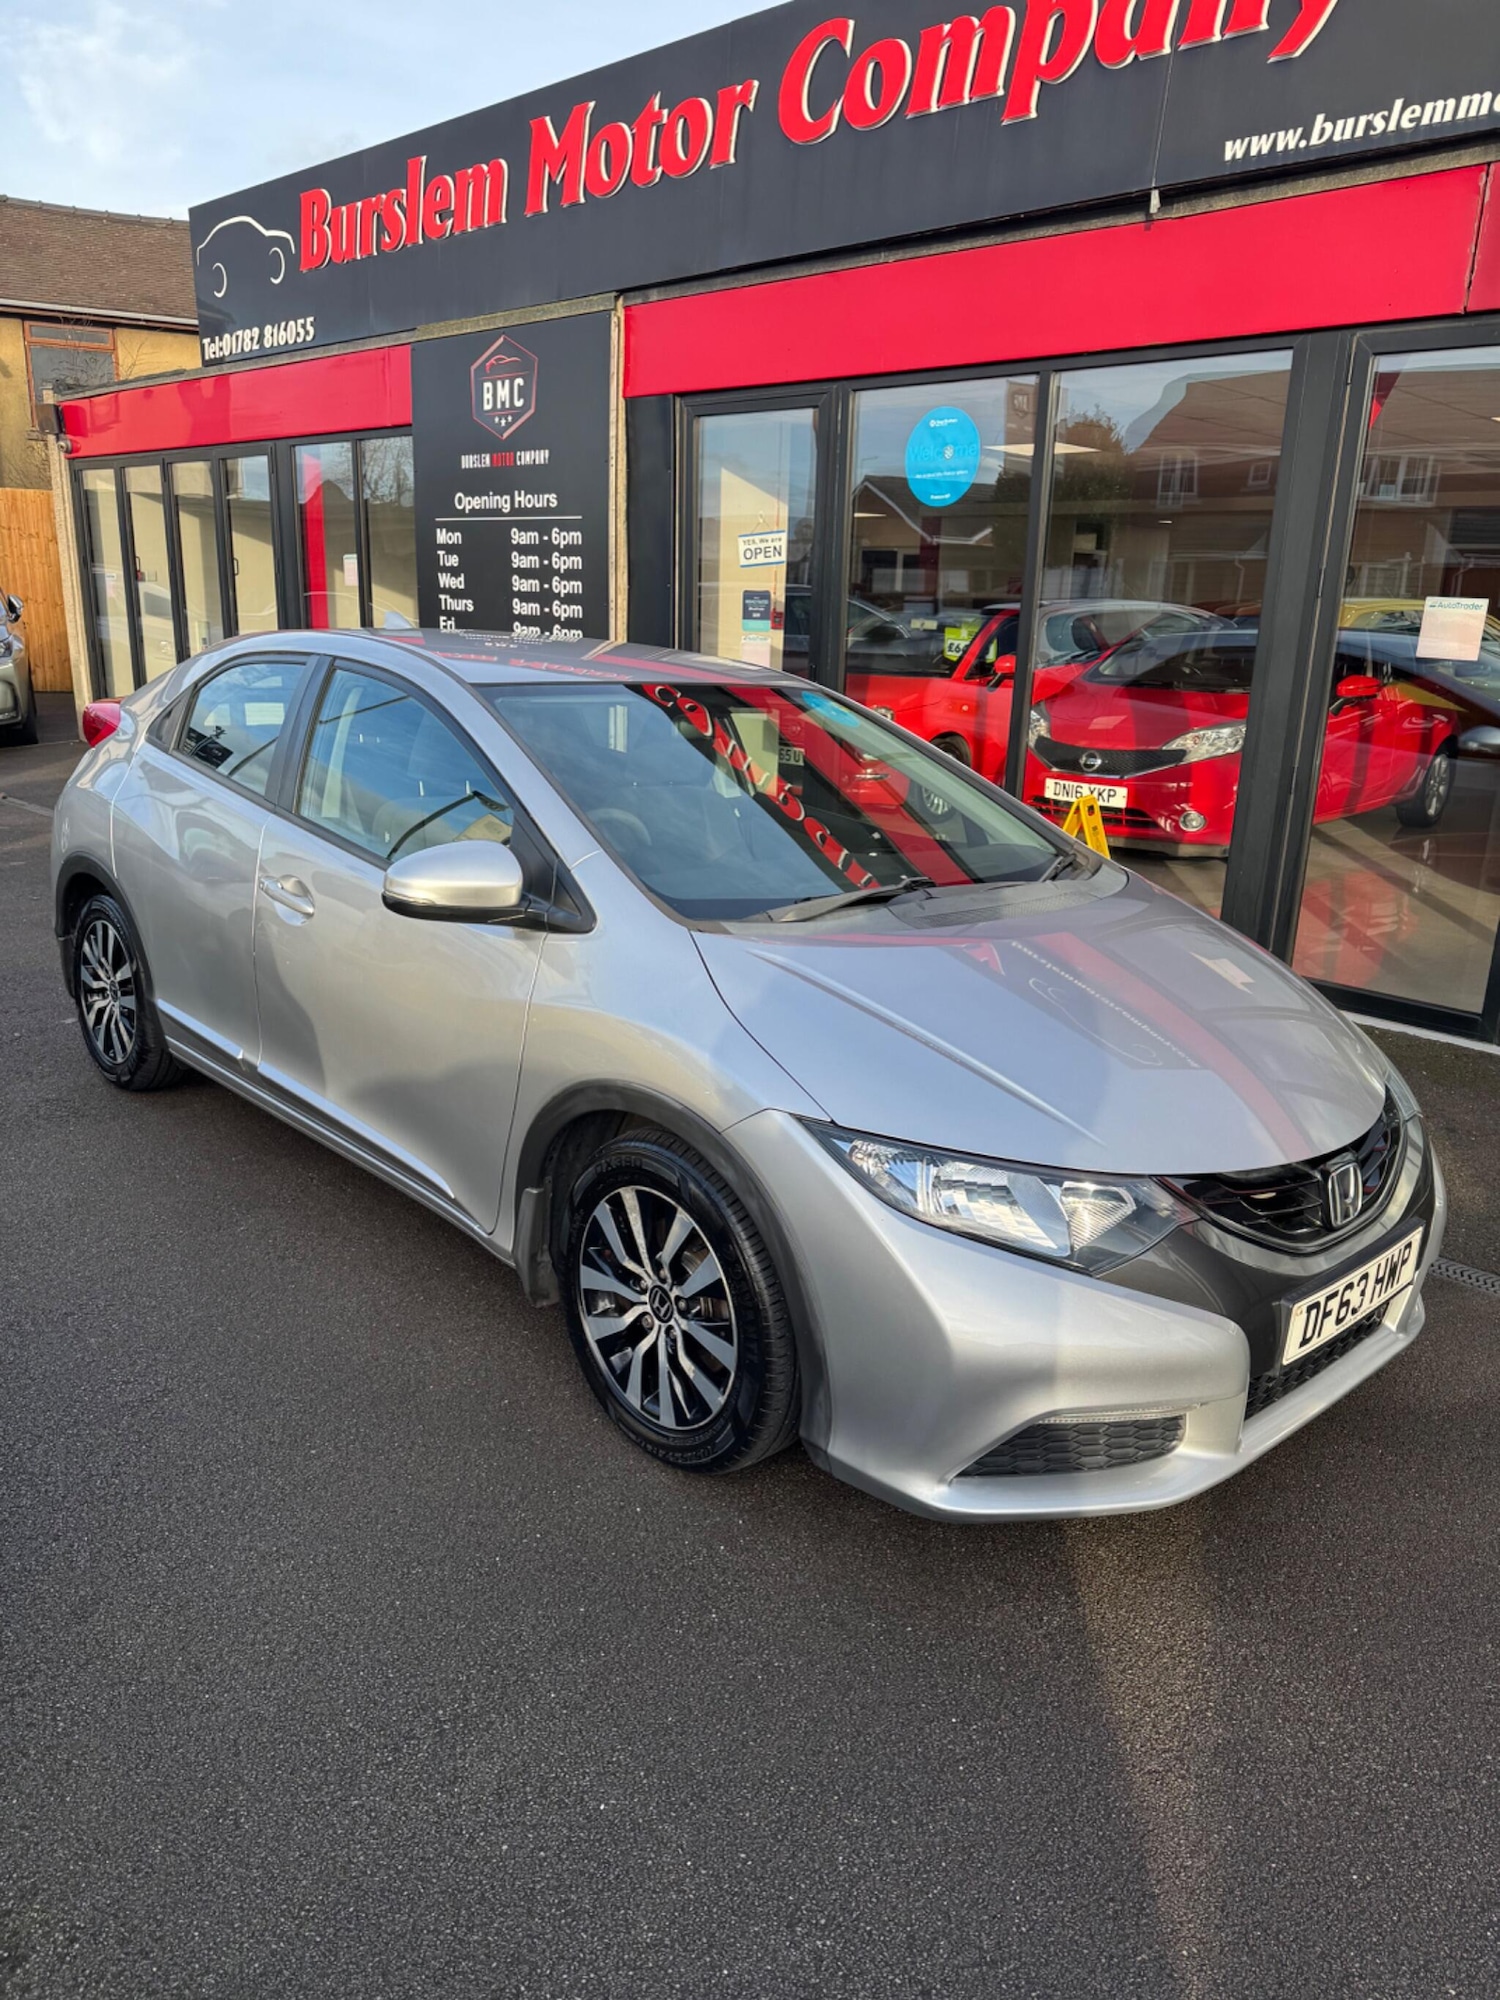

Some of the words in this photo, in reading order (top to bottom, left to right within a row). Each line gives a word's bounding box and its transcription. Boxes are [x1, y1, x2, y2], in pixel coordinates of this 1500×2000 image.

[299, 154, 508, 273] Burslem
[525, 79, 759, 218] Motor
[202, 326, 260, 361] Tel:01782
[263, 316, 315, 349] 816055
[482, 377, 525, 411] BMC
[909, 443, 977, 461] Welcme
[454, 491, 511, 513] Opening
[514, 490, 558, 509] Hours
[436, 528, 462, 545] Mon
[510, 528, 539, 545] 9am
[552, 527, 582, 549] 6pm
[437, 550, 459, 567] Tue
[511, 551, 540, 568] 9am
[552, 551, 582, 573] 6pm
[743, 545, 782, 560] OPEN
[438, 573, 465, 590] Wed
[512, 574, 540, 592] 9am
[552, 576, 583, 598] 6pm
[438, 594, 475, 612] Thurs
[512, 598, 541, 616] 9am
[552, 599, 583, 621] 6pm
[439, 616, 456, 631] Fri
[513, 621, 541, 635] 9am
[1053, 781, 1084, 800] DN16
[1088, 786, 1117, 804] YKP
[1298, 1271, 1370, 1350] DF63
[1369, 1240, 1413, 1305] HWP
